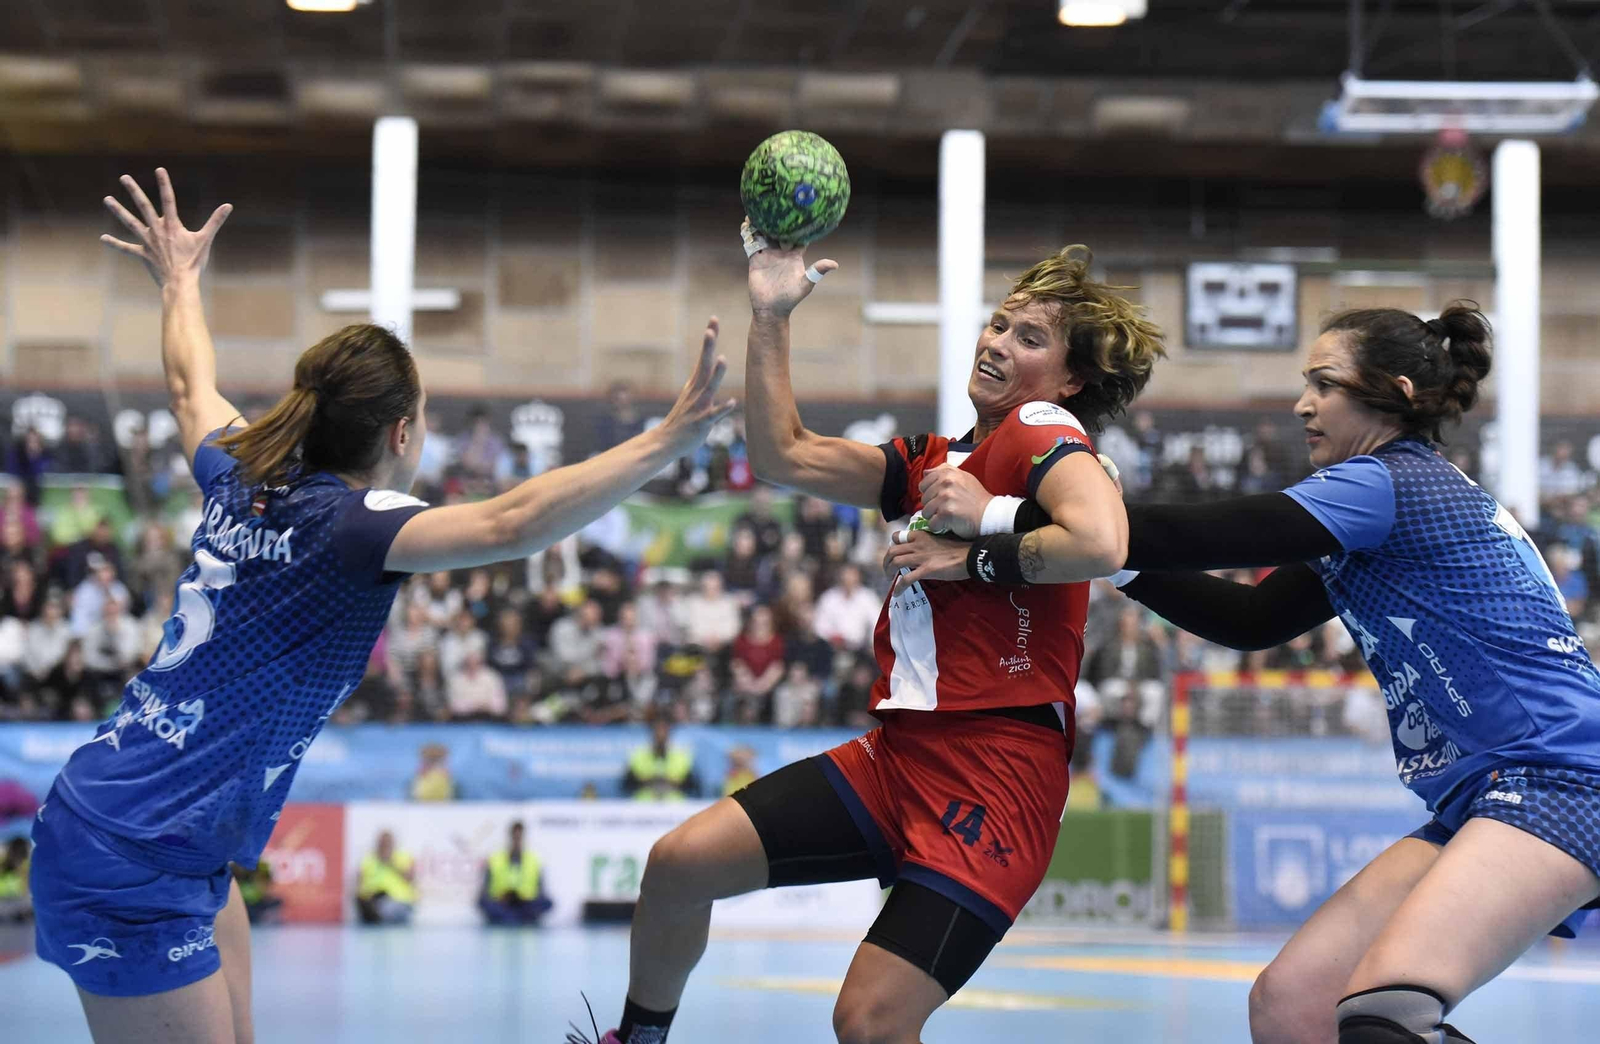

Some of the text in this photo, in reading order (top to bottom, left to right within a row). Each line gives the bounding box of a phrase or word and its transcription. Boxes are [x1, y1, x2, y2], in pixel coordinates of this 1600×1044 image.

[1009, 592, 1033, 655] galici
[1008, 662, 1031, 673] ZICO
[1418, 642, 1473, 718] SPYRO
[940, 801, 987, 847] 14
[983, 848, 1008, 868] ZICO
[167, 936, 217, 962] GIPUZ
